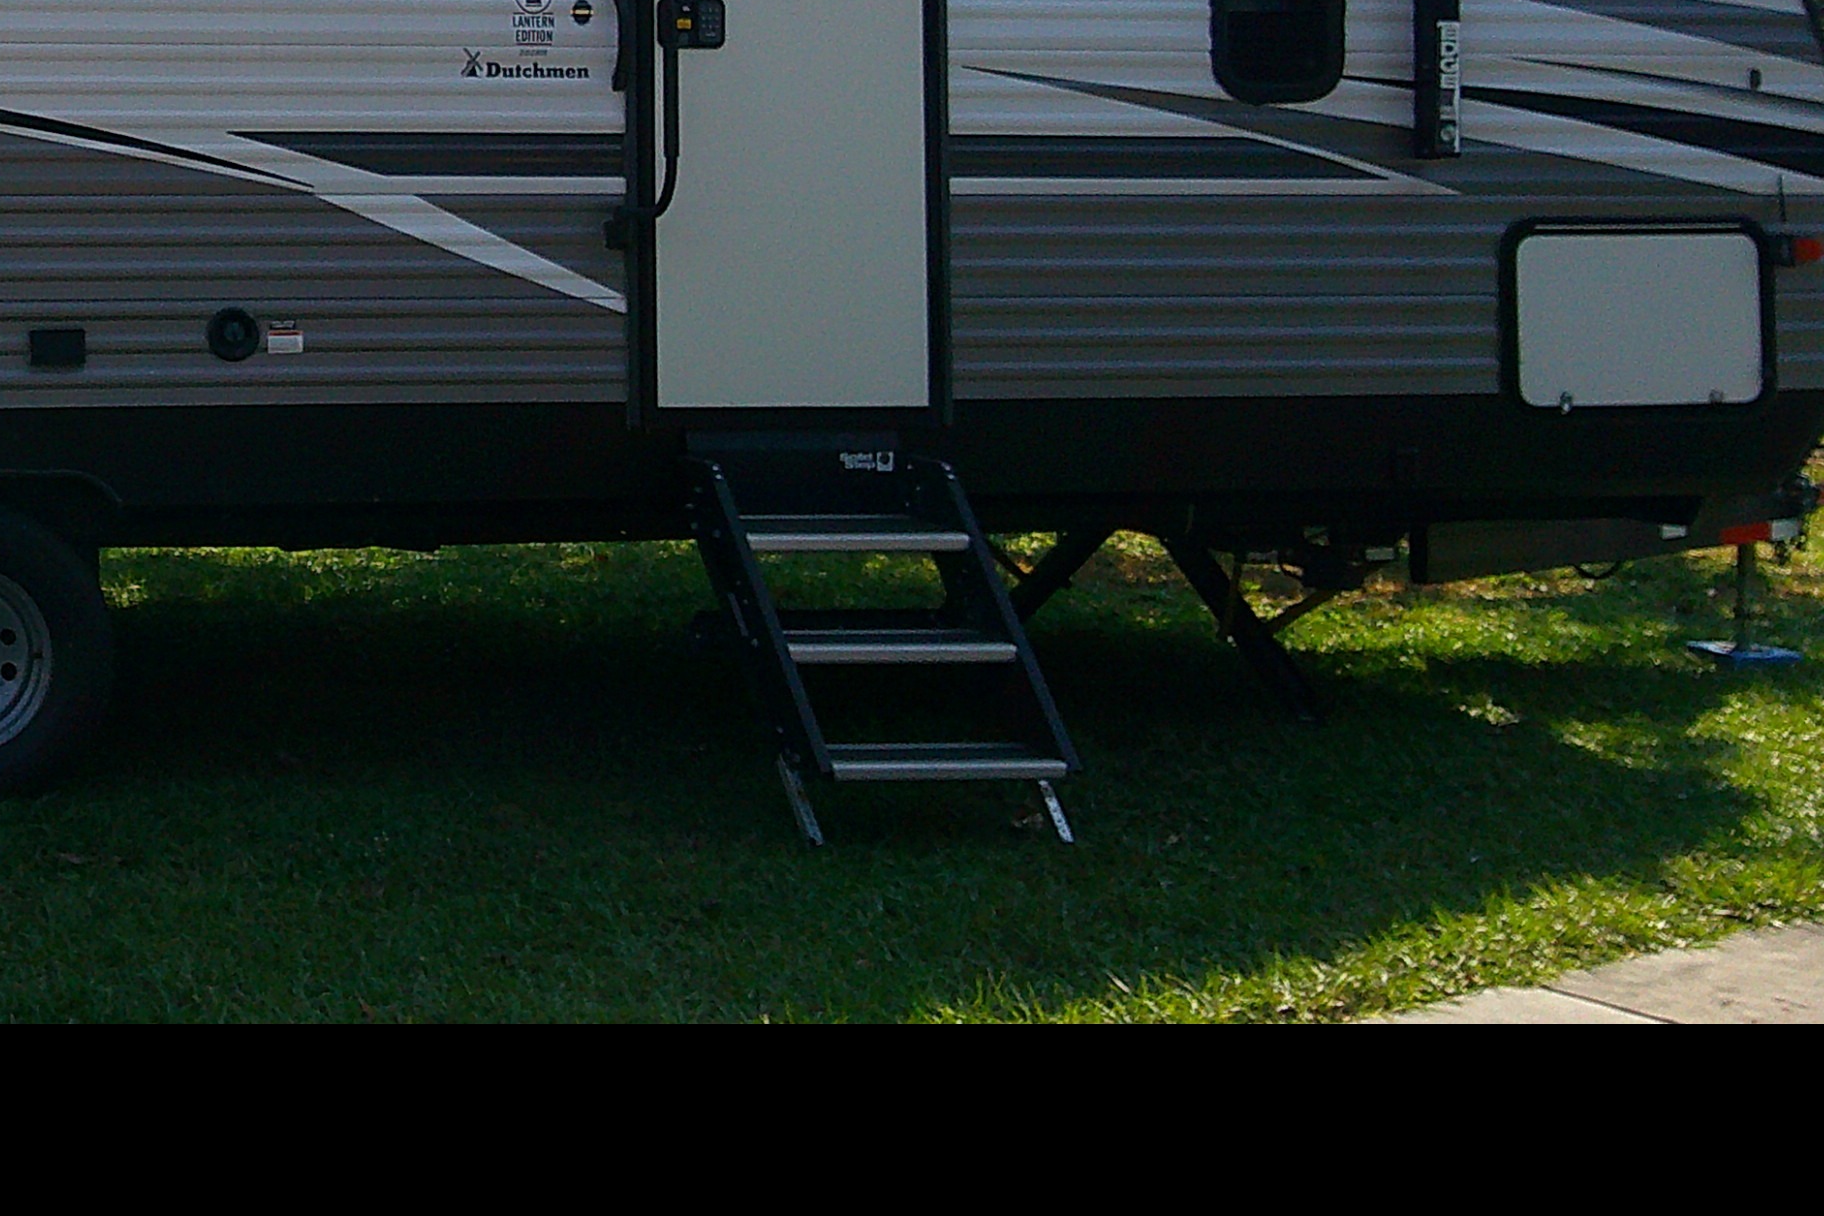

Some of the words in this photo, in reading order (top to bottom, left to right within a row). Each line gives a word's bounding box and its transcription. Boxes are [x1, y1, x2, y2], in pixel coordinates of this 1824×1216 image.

[512, 16, 555, 28] LANTERN
[515, 29, 553, 42] EDITION
[485, 62, 590, 78] Dutchmen
